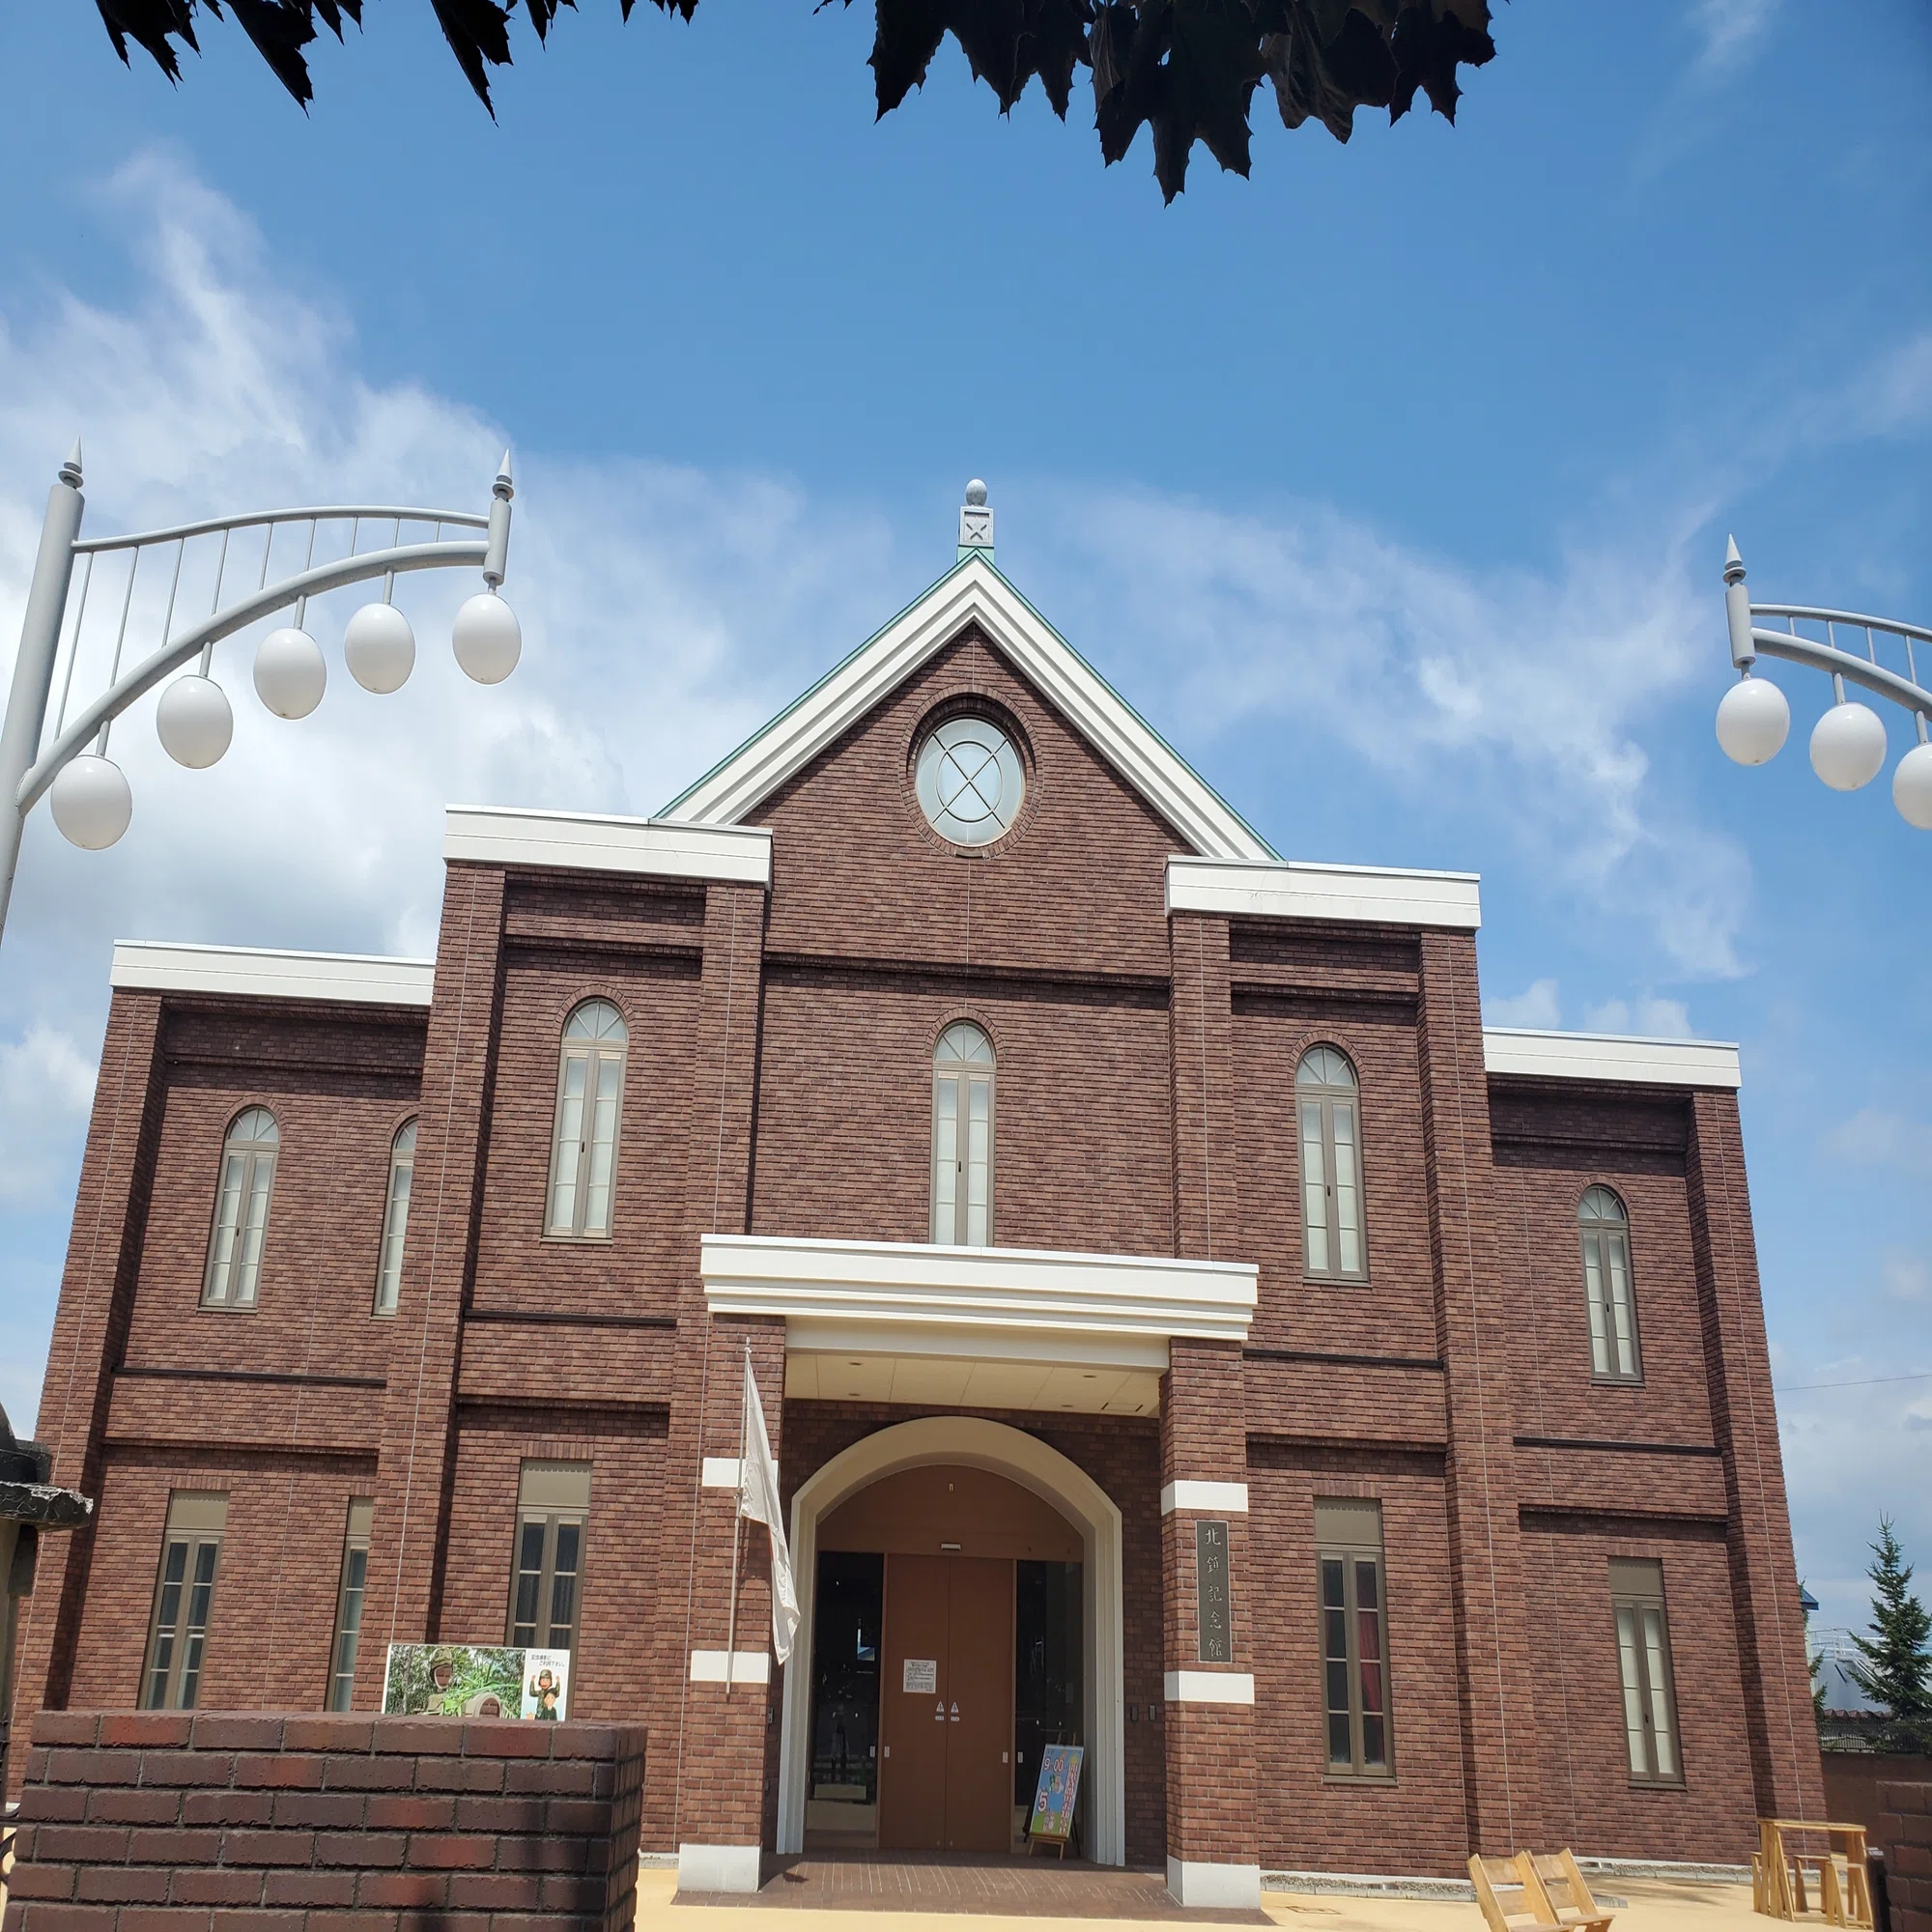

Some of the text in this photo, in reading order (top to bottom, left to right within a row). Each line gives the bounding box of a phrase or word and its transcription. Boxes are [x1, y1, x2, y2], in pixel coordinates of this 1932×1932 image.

[1205, 1527, 1223, 1658] 北鎮記念館
